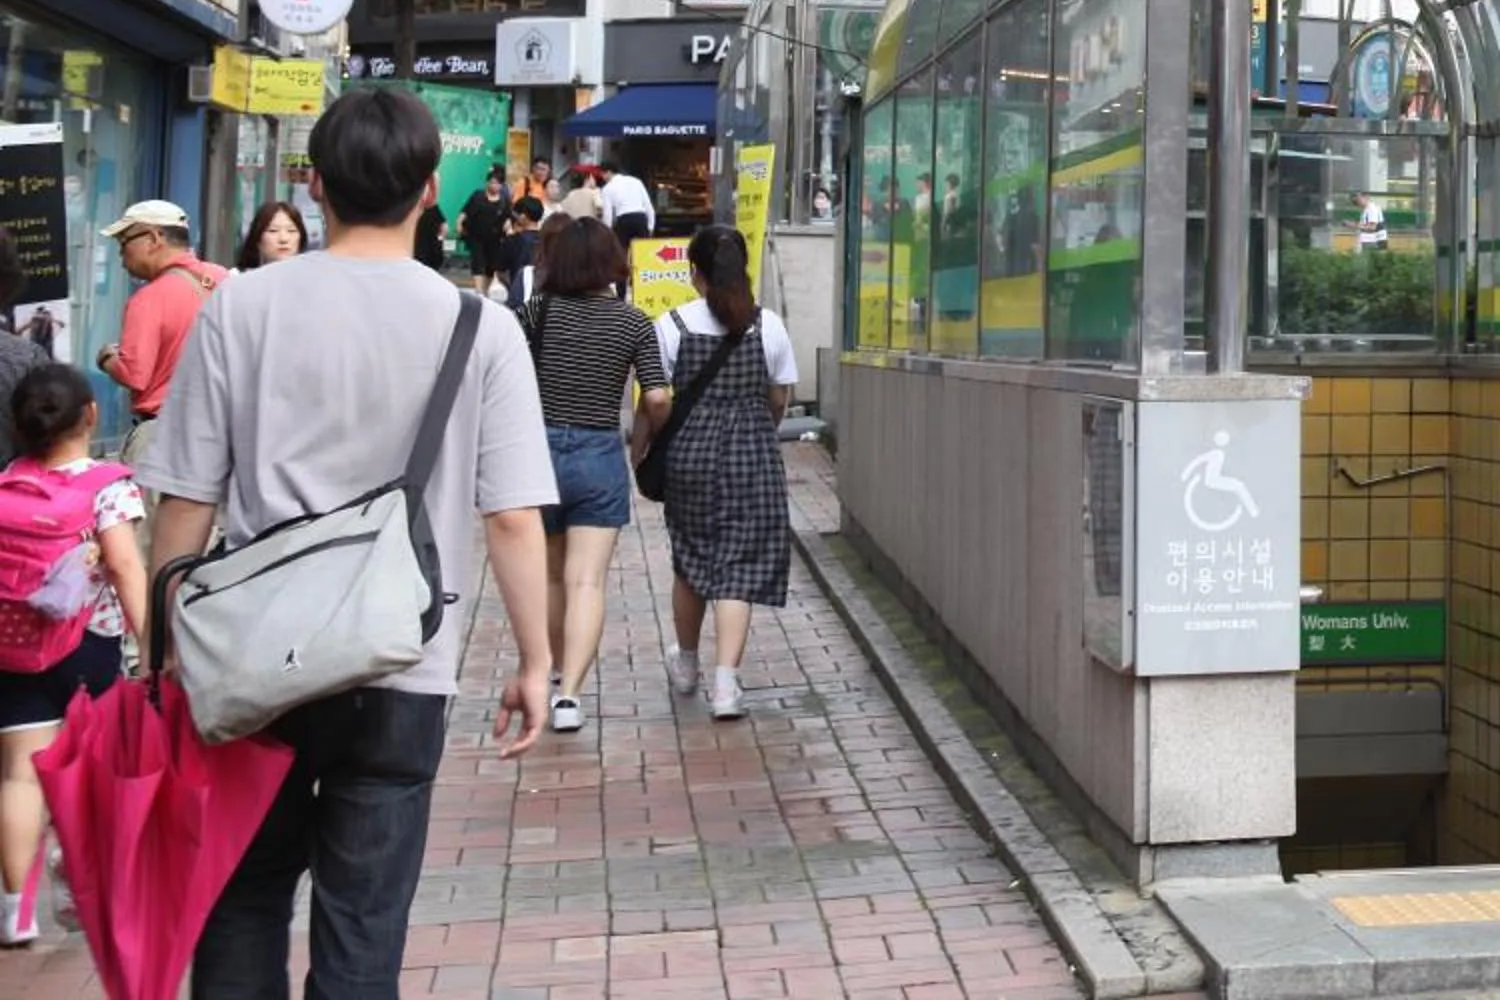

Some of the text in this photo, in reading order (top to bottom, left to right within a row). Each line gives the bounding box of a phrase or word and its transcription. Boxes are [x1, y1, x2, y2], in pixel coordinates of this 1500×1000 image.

[445, 55, 489, 75] Bean
[623, 125, 707, 135] PARIS BAGUETTE
[1167, 538, 1272, 566] 편의시설
[1166, 566, 1274, 595] 이용안내
[1302, 611, 1410, 630] Womans Univ.
